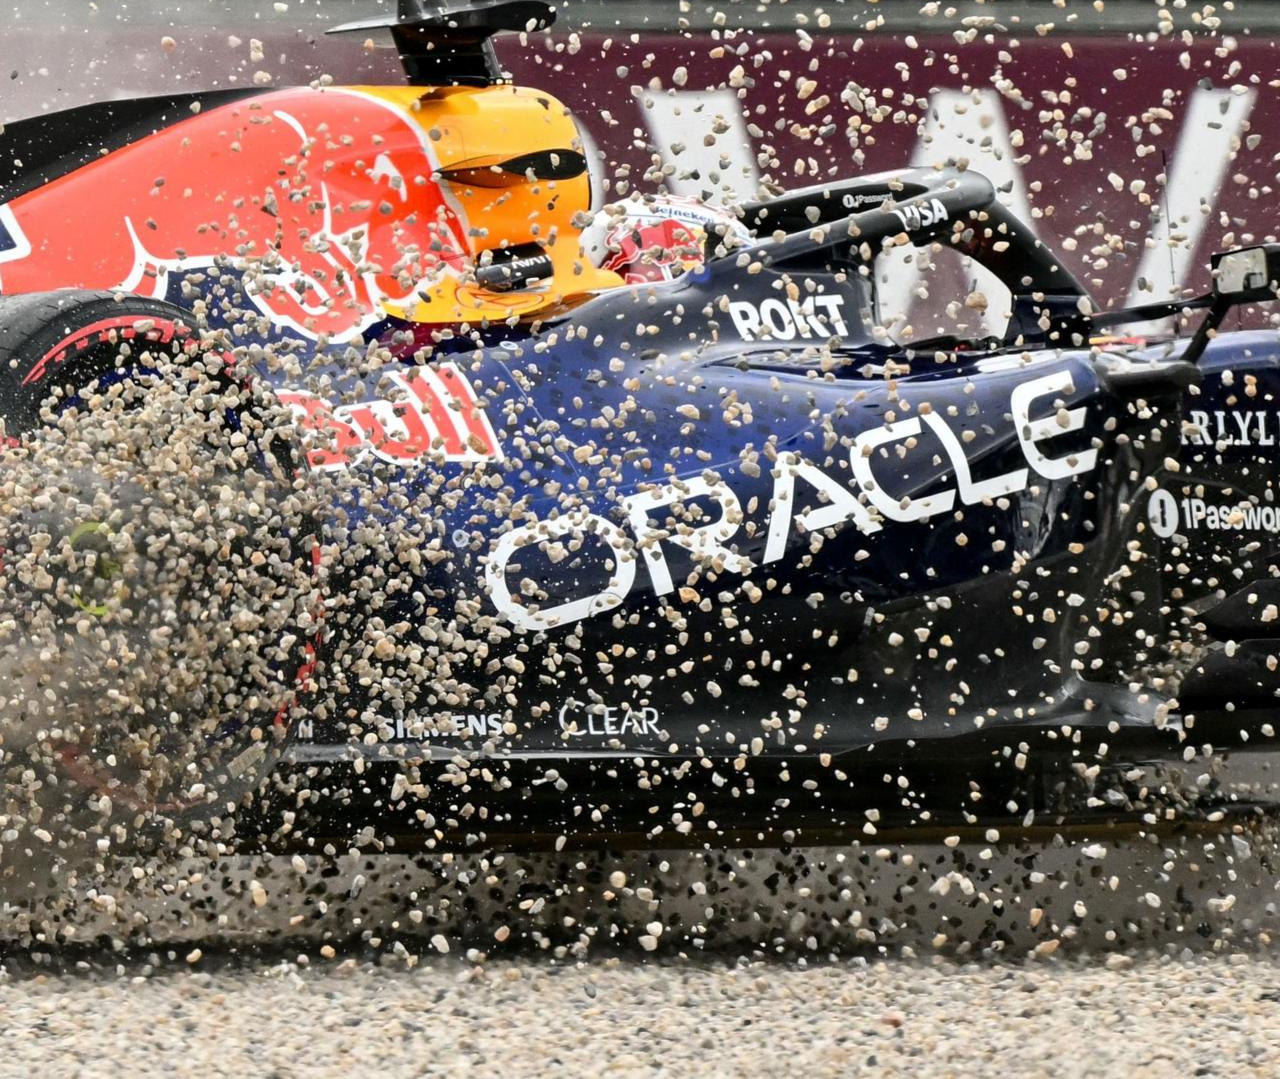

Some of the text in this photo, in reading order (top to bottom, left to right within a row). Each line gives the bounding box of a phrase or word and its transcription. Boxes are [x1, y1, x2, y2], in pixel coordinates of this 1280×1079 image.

[728, 295, 849, 342] ROKT
[485, 369, 1100, 631] ORACLE
[558, 700, 661, 736] CLEAR
